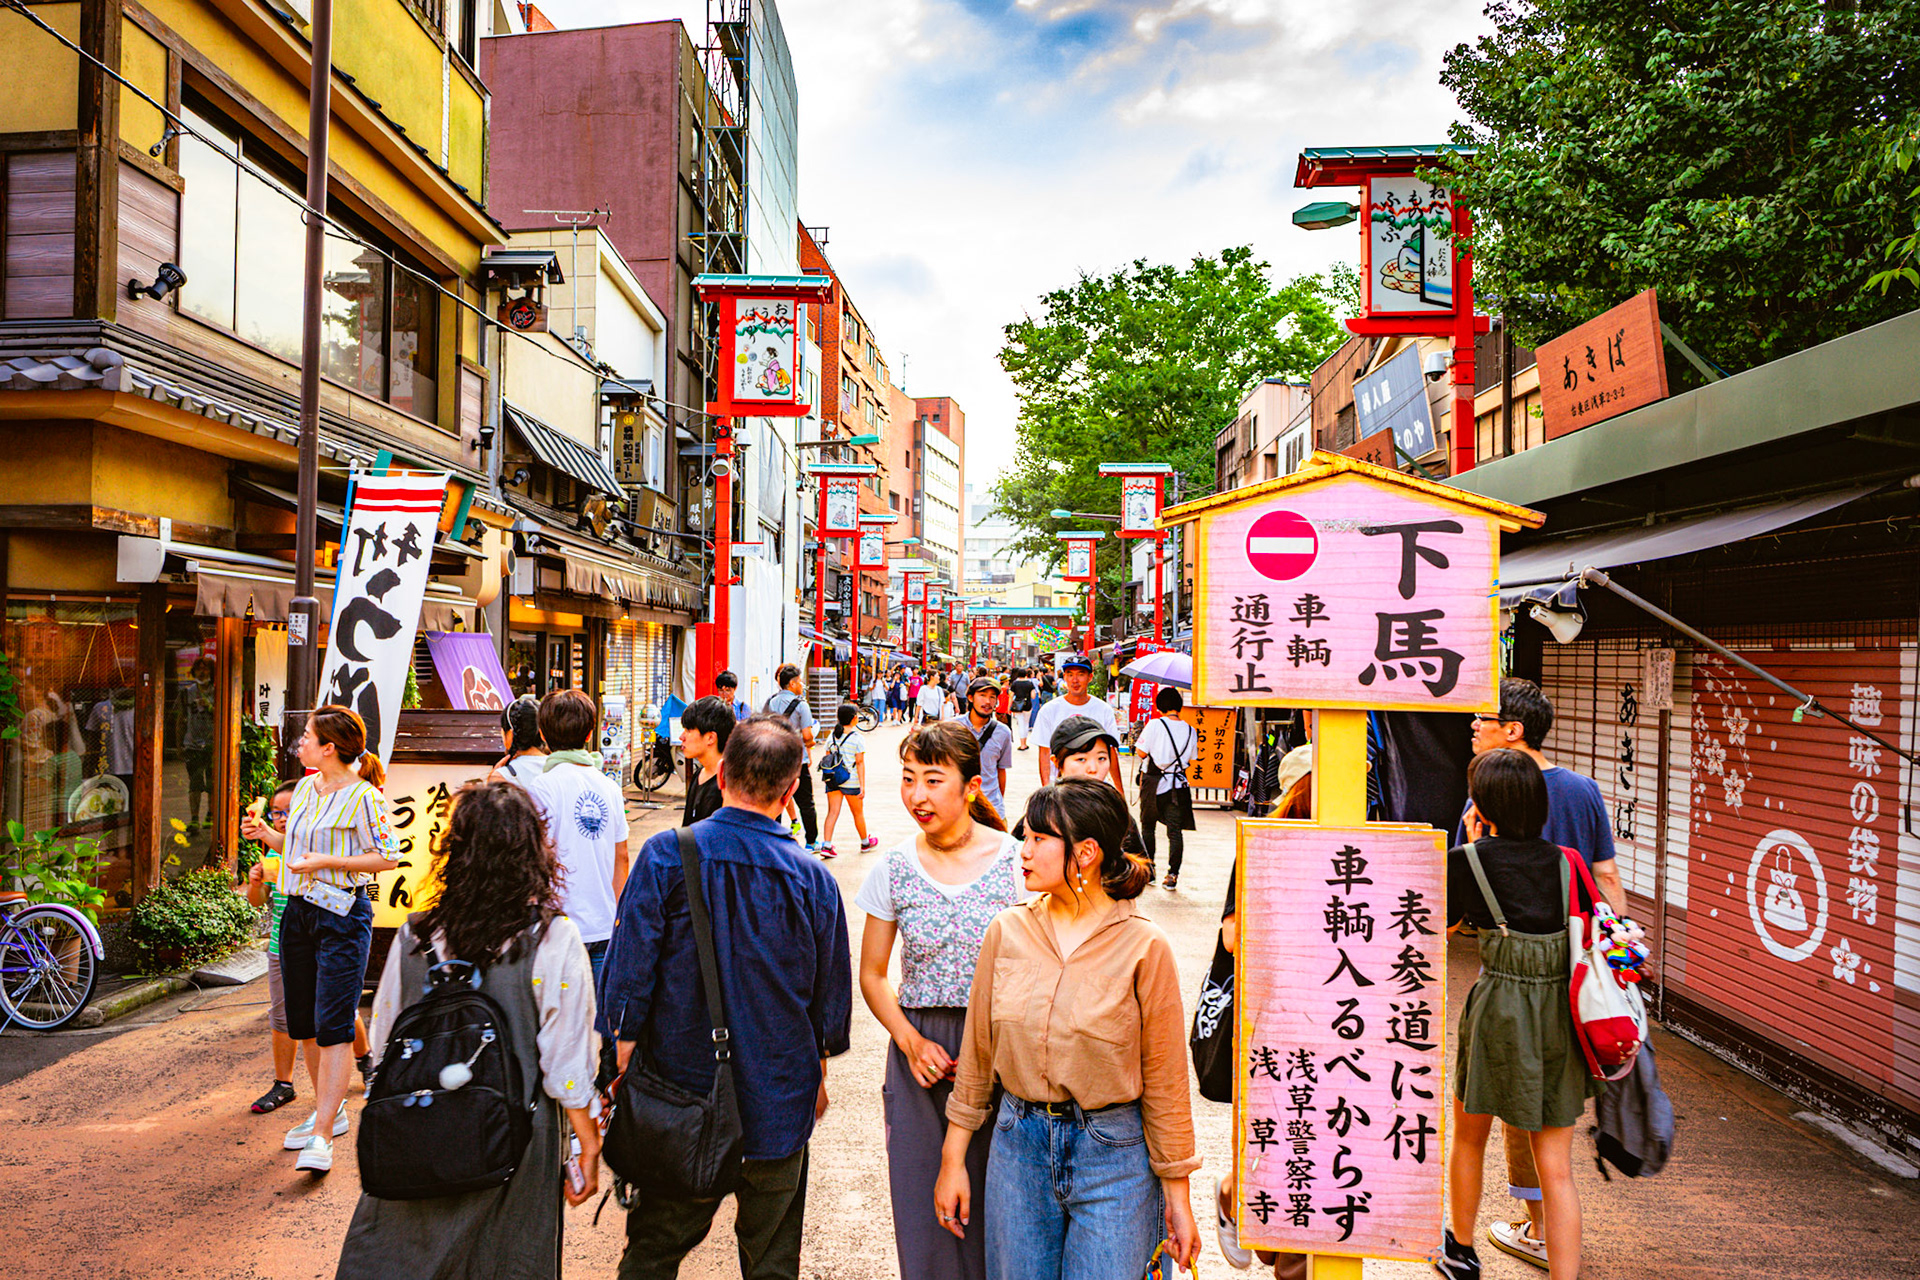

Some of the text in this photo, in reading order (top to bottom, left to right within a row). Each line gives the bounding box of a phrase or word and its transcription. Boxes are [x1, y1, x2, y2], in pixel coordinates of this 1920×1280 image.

[1563, 328, 1626, 392] あきば
[1229, 593, 1274, 693] 通行止
[1287, 593, 1332, 668] 車輌
[1358, 519, 1465, 698] 下馬
[1213, 727, 1226, 774] 切子の店
[1616, 682, 1639, 841] あきば
[1321, 844, 1375, 1243] 車輌入るべからず
[1384, 889, 1438, 1164] 表参道に付
[1247, 1046, 1281, 1226] 浅草寺
[1284, 1048, 1318, 1228] 浅草警察署
